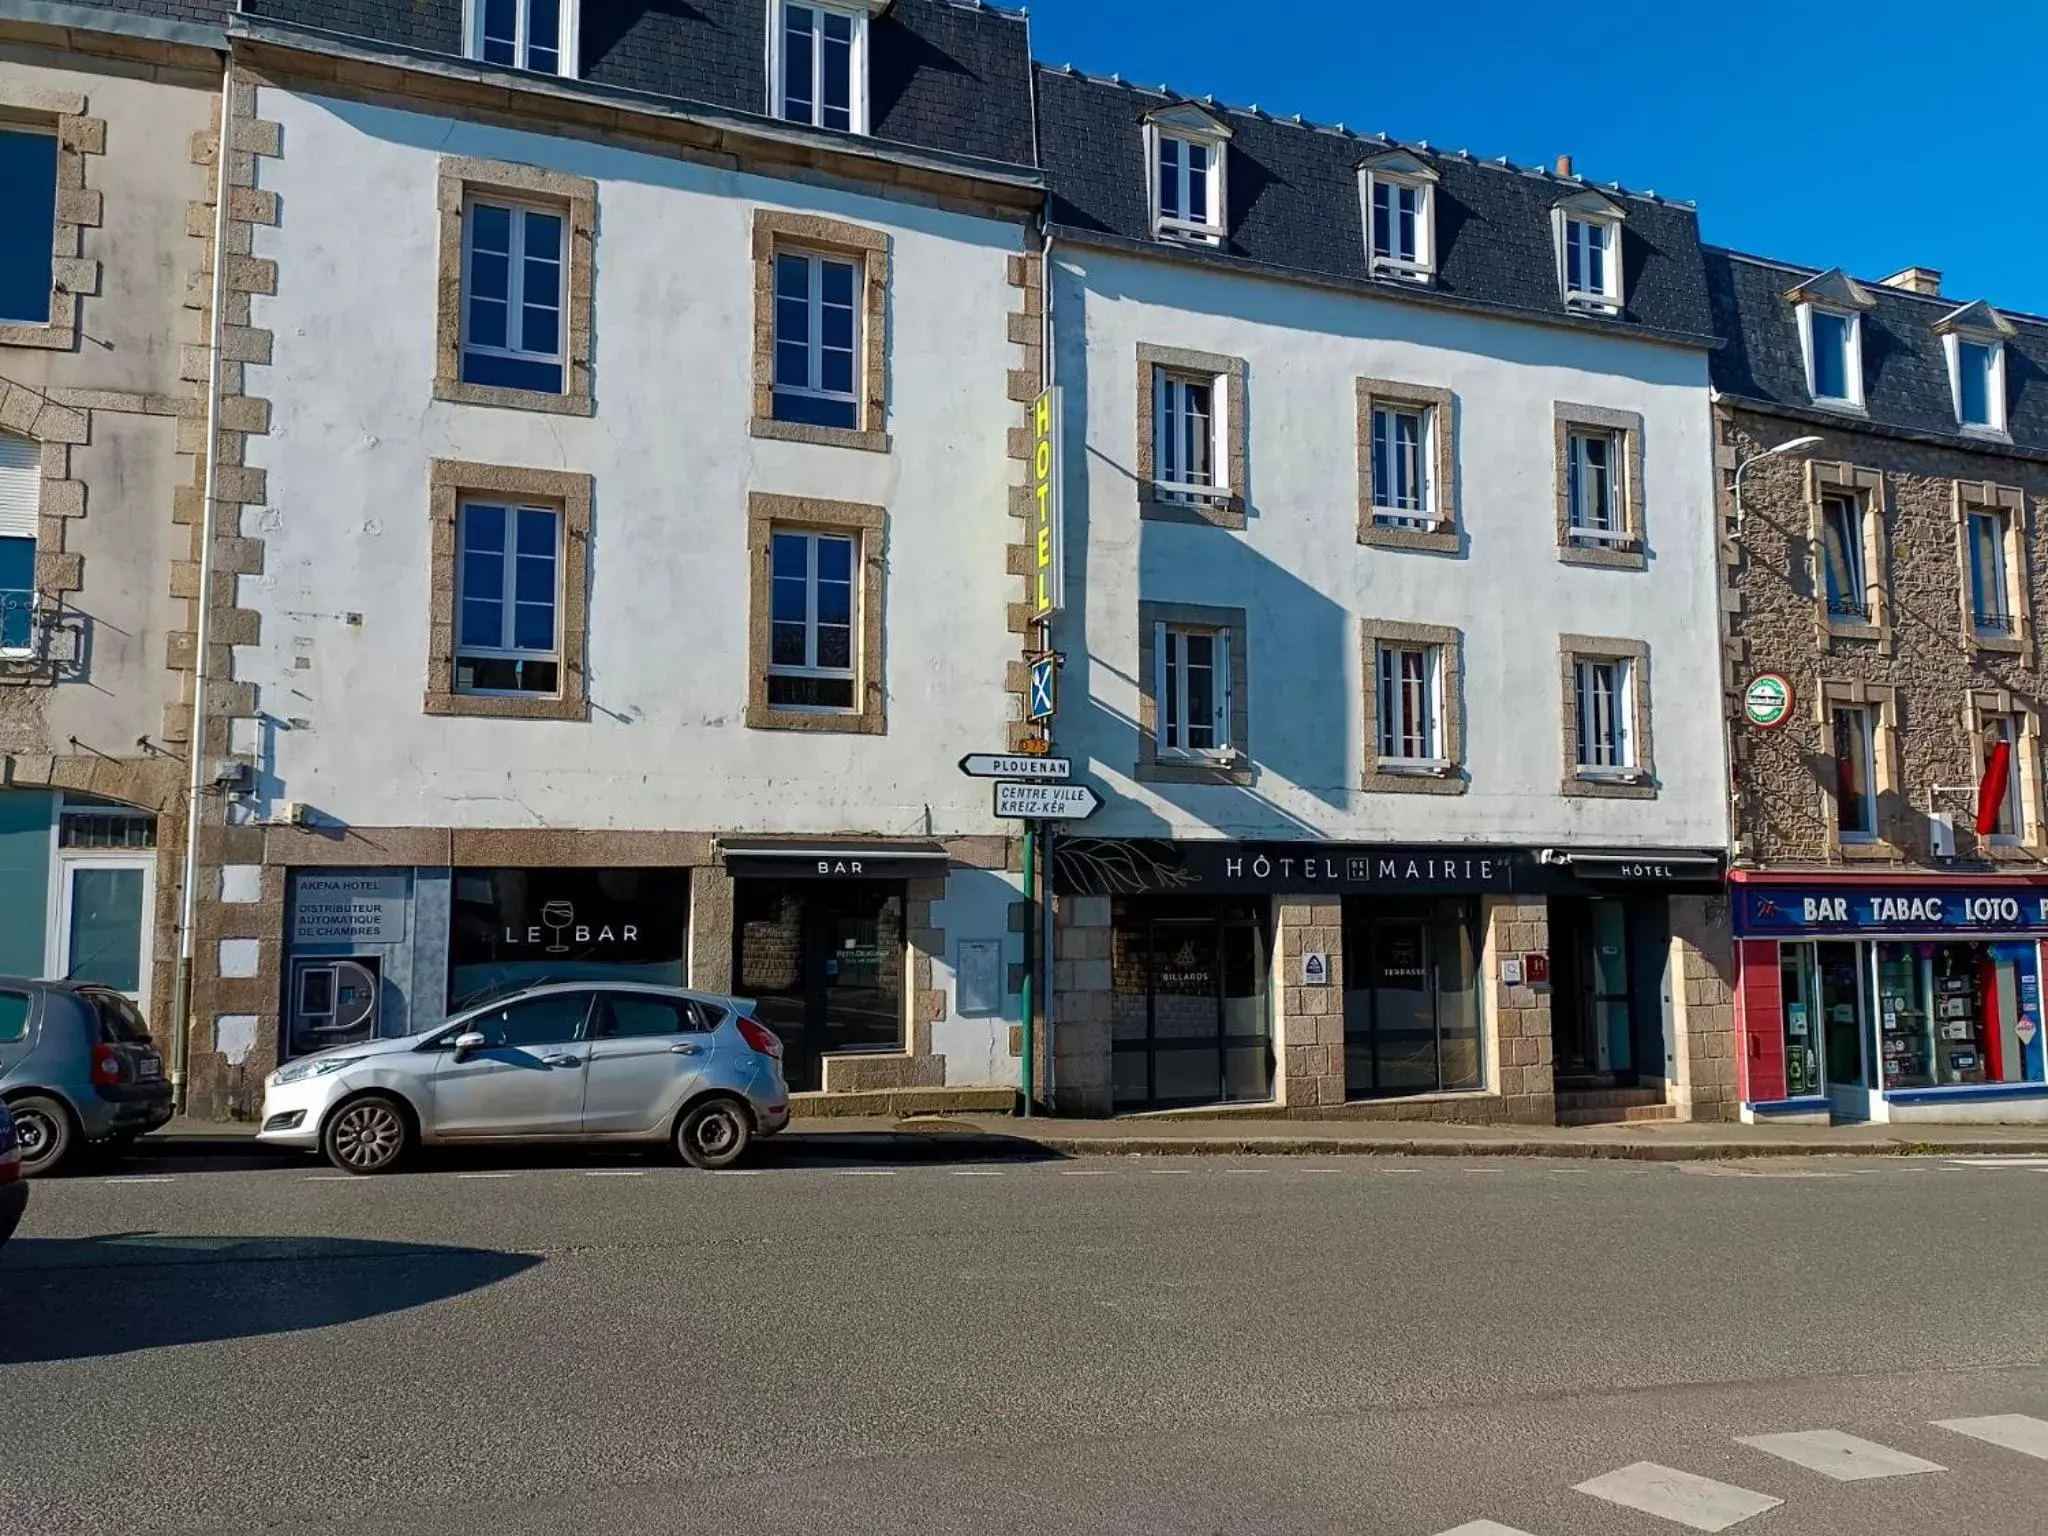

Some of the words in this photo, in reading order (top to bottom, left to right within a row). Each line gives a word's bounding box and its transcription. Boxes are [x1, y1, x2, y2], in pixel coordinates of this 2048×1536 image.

[1036, 393, 1050, 612] HOTEL
[993, 760, 1066, 774] PLOUENAN
[1001, 787, 1047, 800] CENTRE
[1053, 789, 1086, 801] VILLE
[817, 861, 862, 874] BAR
[1226, 854, 1338, 878] HÔTEL
[1379, 859, 1493, 879] MAIRIE
[1621, 863, 1672, 877] HÔTEL
[300, 881, 340, 890] AKENA
[299, 904, 382, 913] DISTRIBUTEUR
[1803, 897, 1848, 921] BAR
[1870, 897, 1943, 921] TABAC
[1965, 897, 2019, 921] LOTO
[299, 915, 382, 925] AUTOMATIQUE
[298, 928, 315, 937] DE
[318, 926, 381, 937] CHAMBRES
[506, 926, 541, 943] LE
[575, 925, 638, 942] BAR
